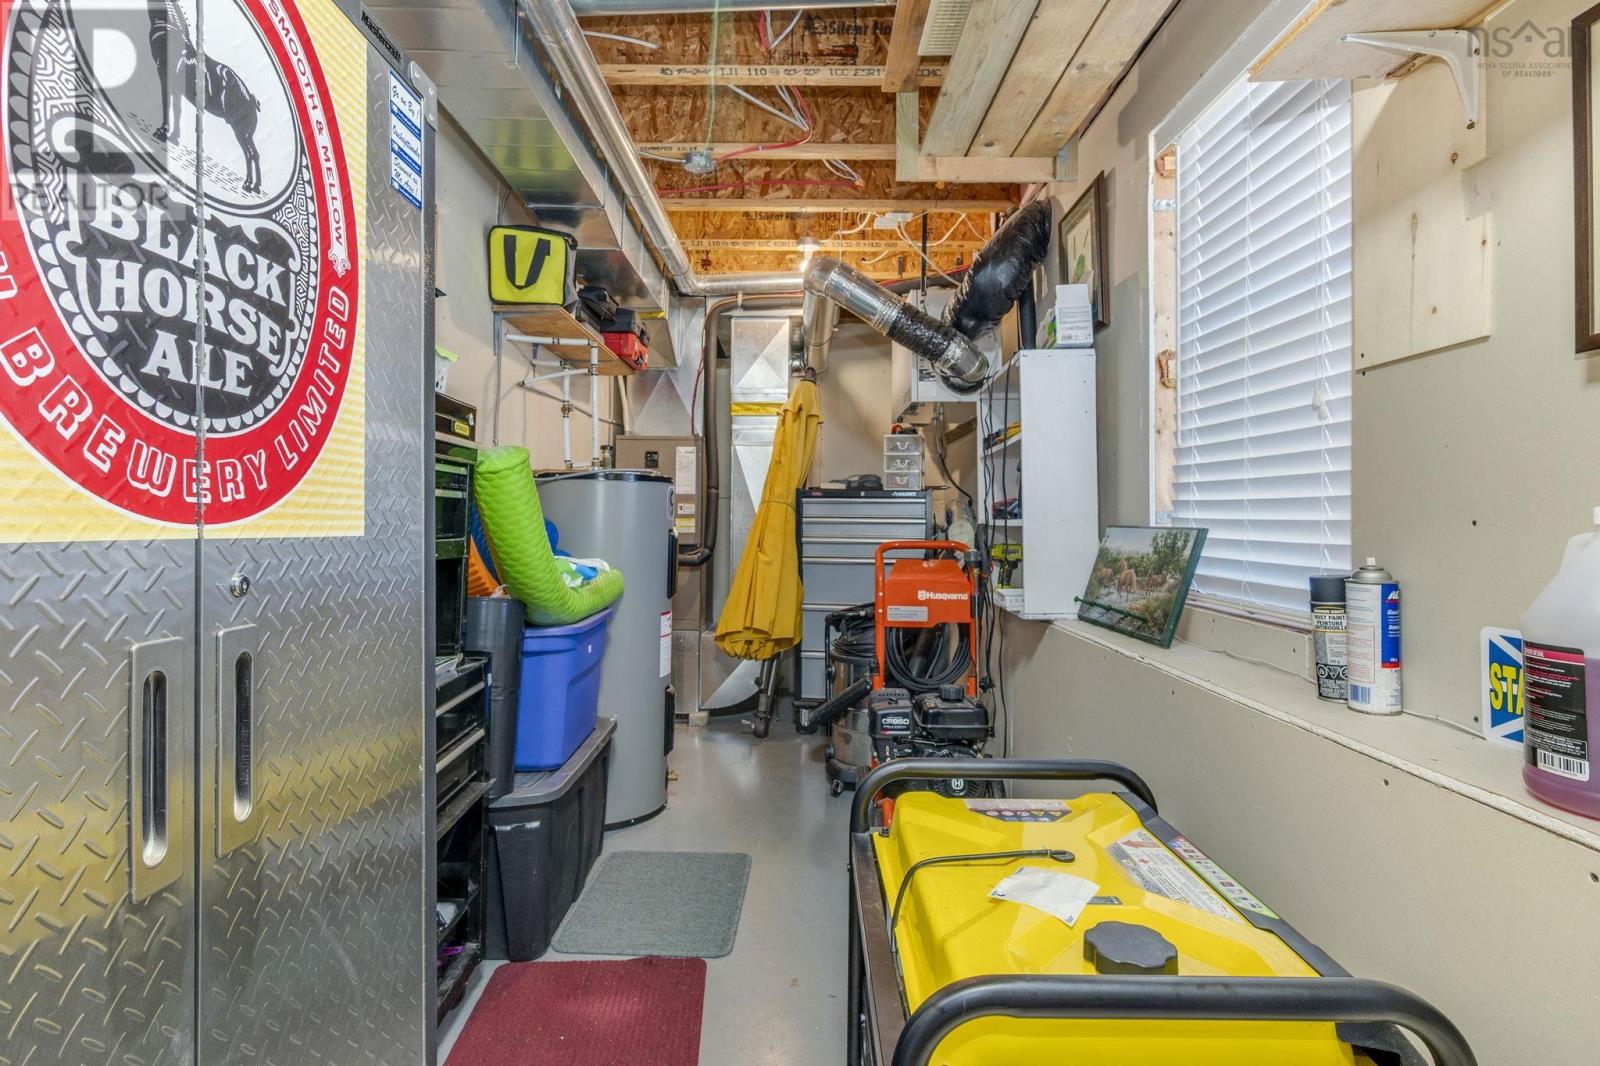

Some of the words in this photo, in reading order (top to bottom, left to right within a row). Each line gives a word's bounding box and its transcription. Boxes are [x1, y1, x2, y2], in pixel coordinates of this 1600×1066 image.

[361, 10, 402, 64] Mastercraft
[268, 0, 319, 111] SMOOTH
[321, 145, 343, 246] MELLOW
[90, 175, 288, 306] BLACK
[97, 258, 285, 363] HORSE
[141, 329, 254, 397] ALE
[0, 327, 268, 504] BREWERY
[275, 285, 349, 471] LIMITED
[926, 592, 969, 600] Husqvarna
